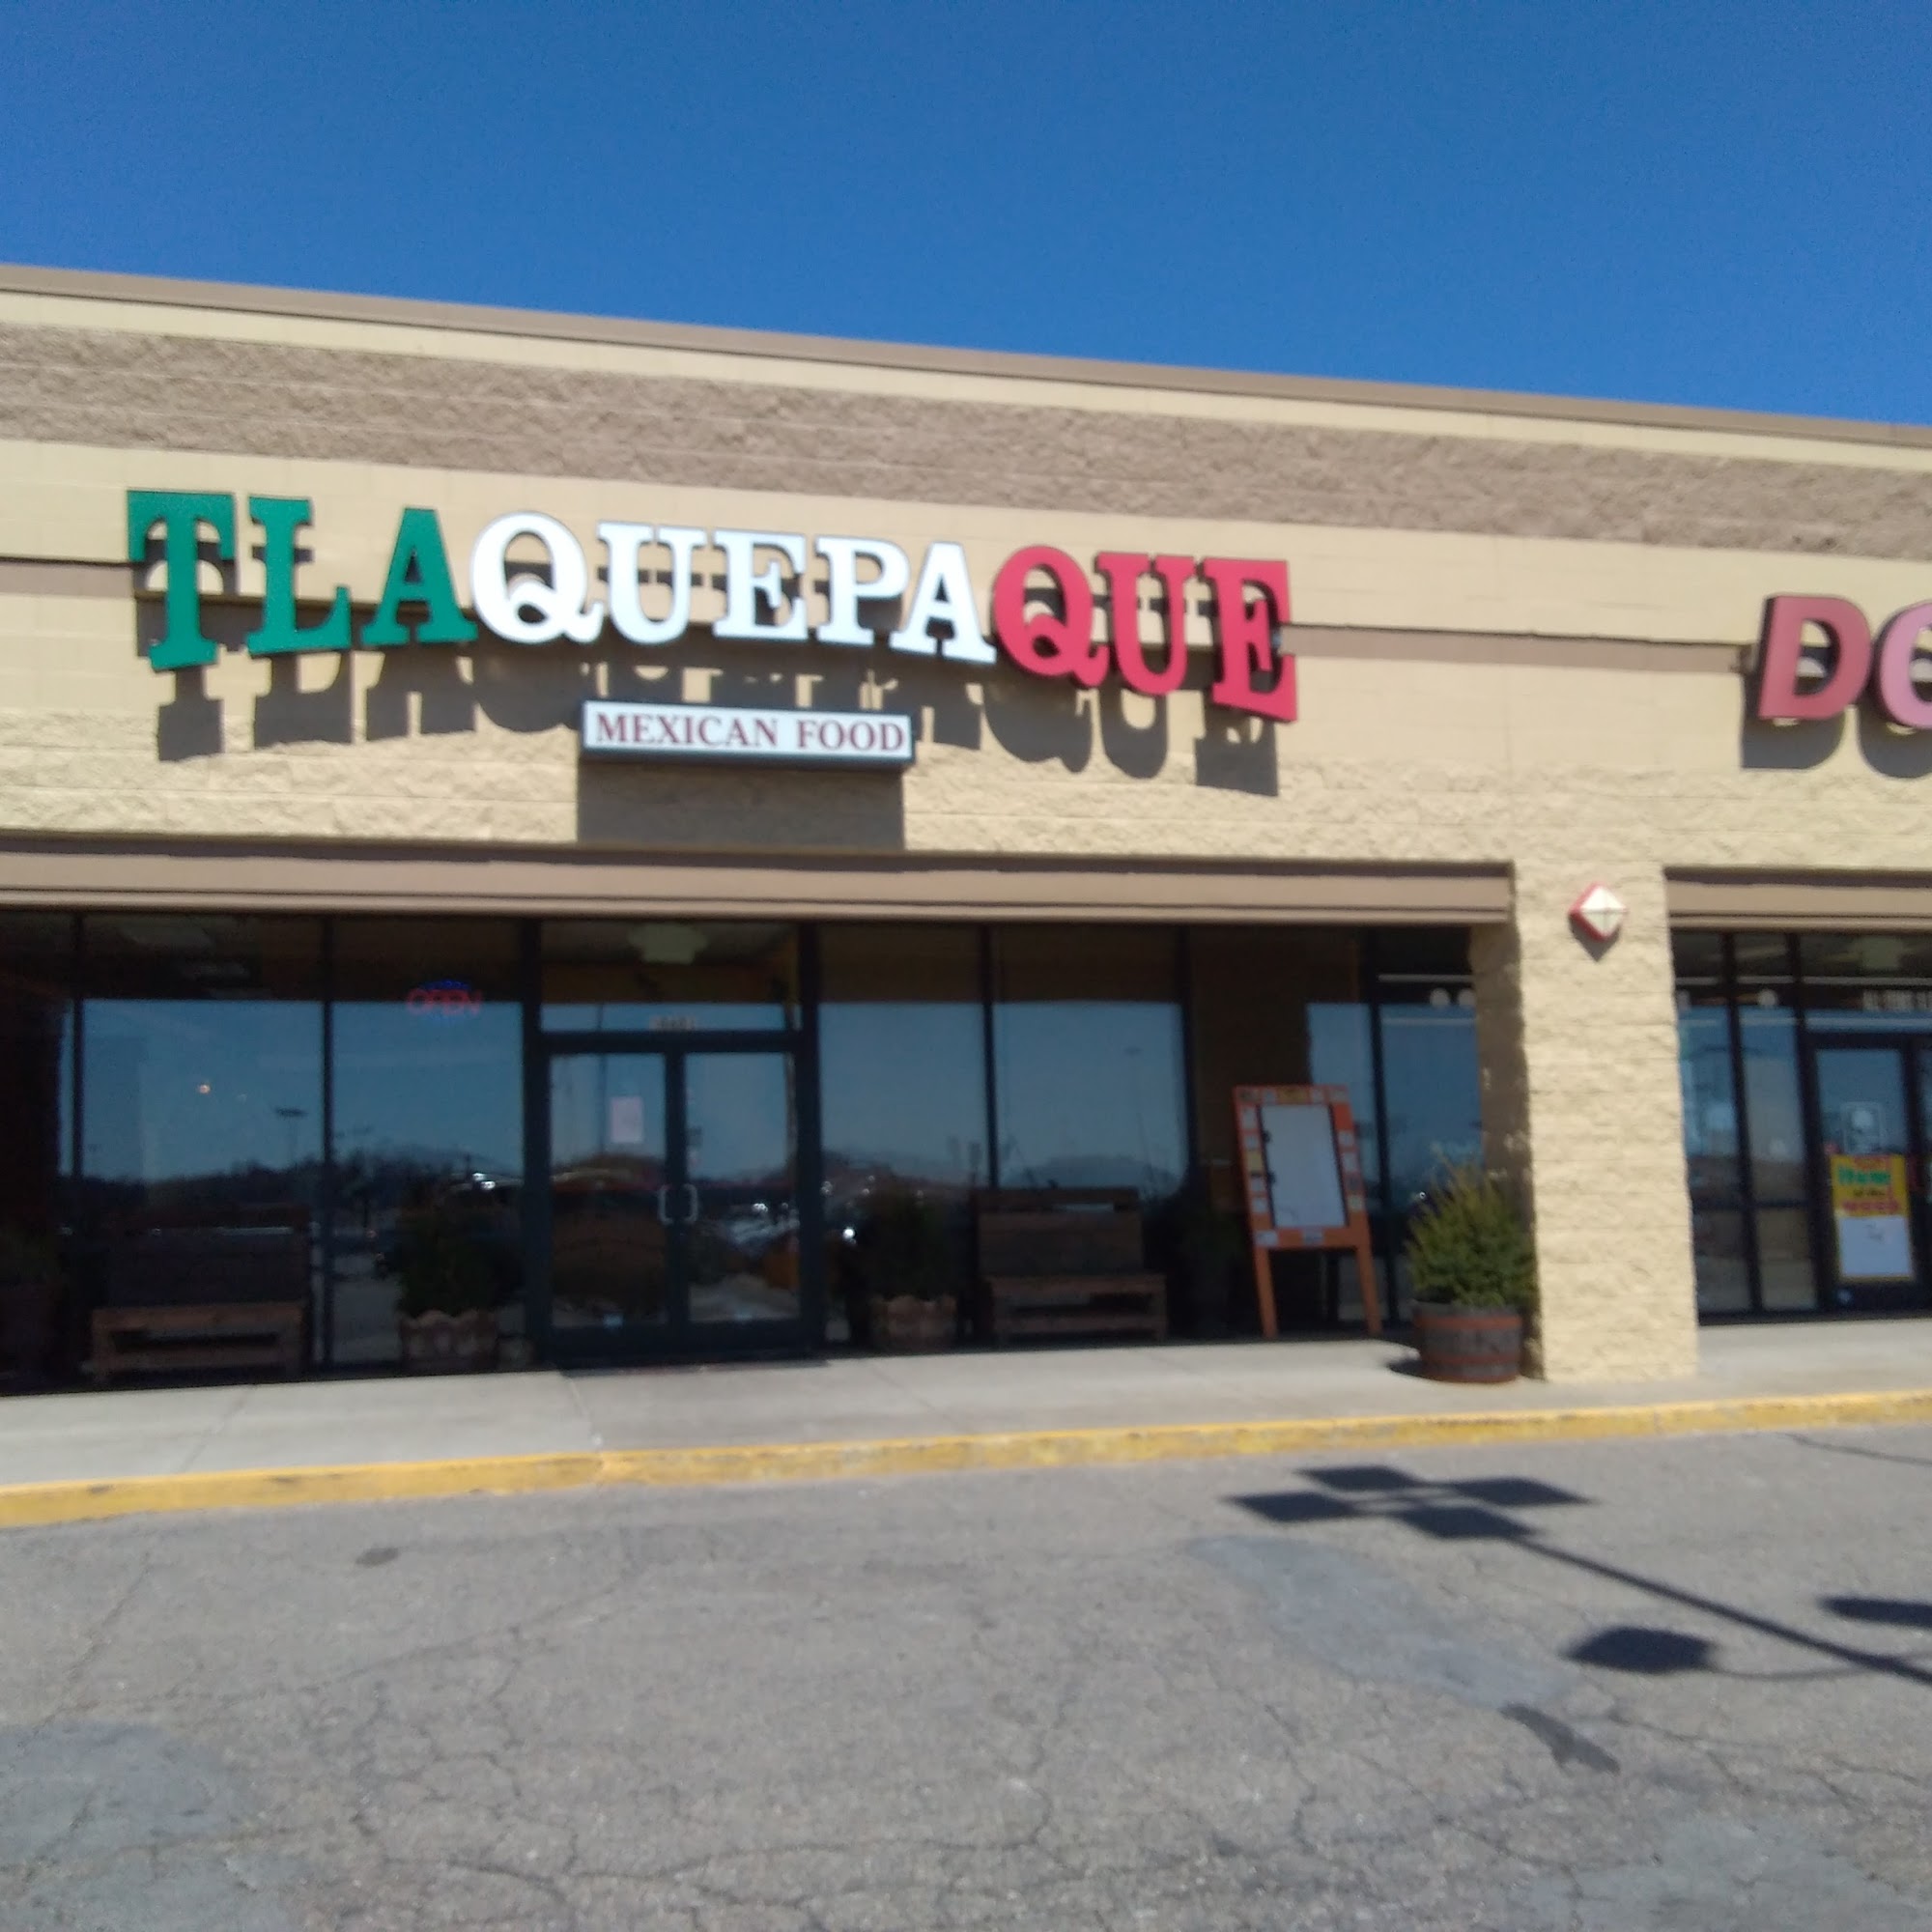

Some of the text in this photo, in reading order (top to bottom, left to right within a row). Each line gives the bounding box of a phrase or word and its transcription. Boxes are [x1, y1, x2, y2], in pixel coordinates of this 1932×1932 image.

[127, 489, 1298, 723] TLAQUEPAQUE
[595, 712, 905, 752] MEXICAN FOOD
[406, 987, 483, 1017] OPEN
